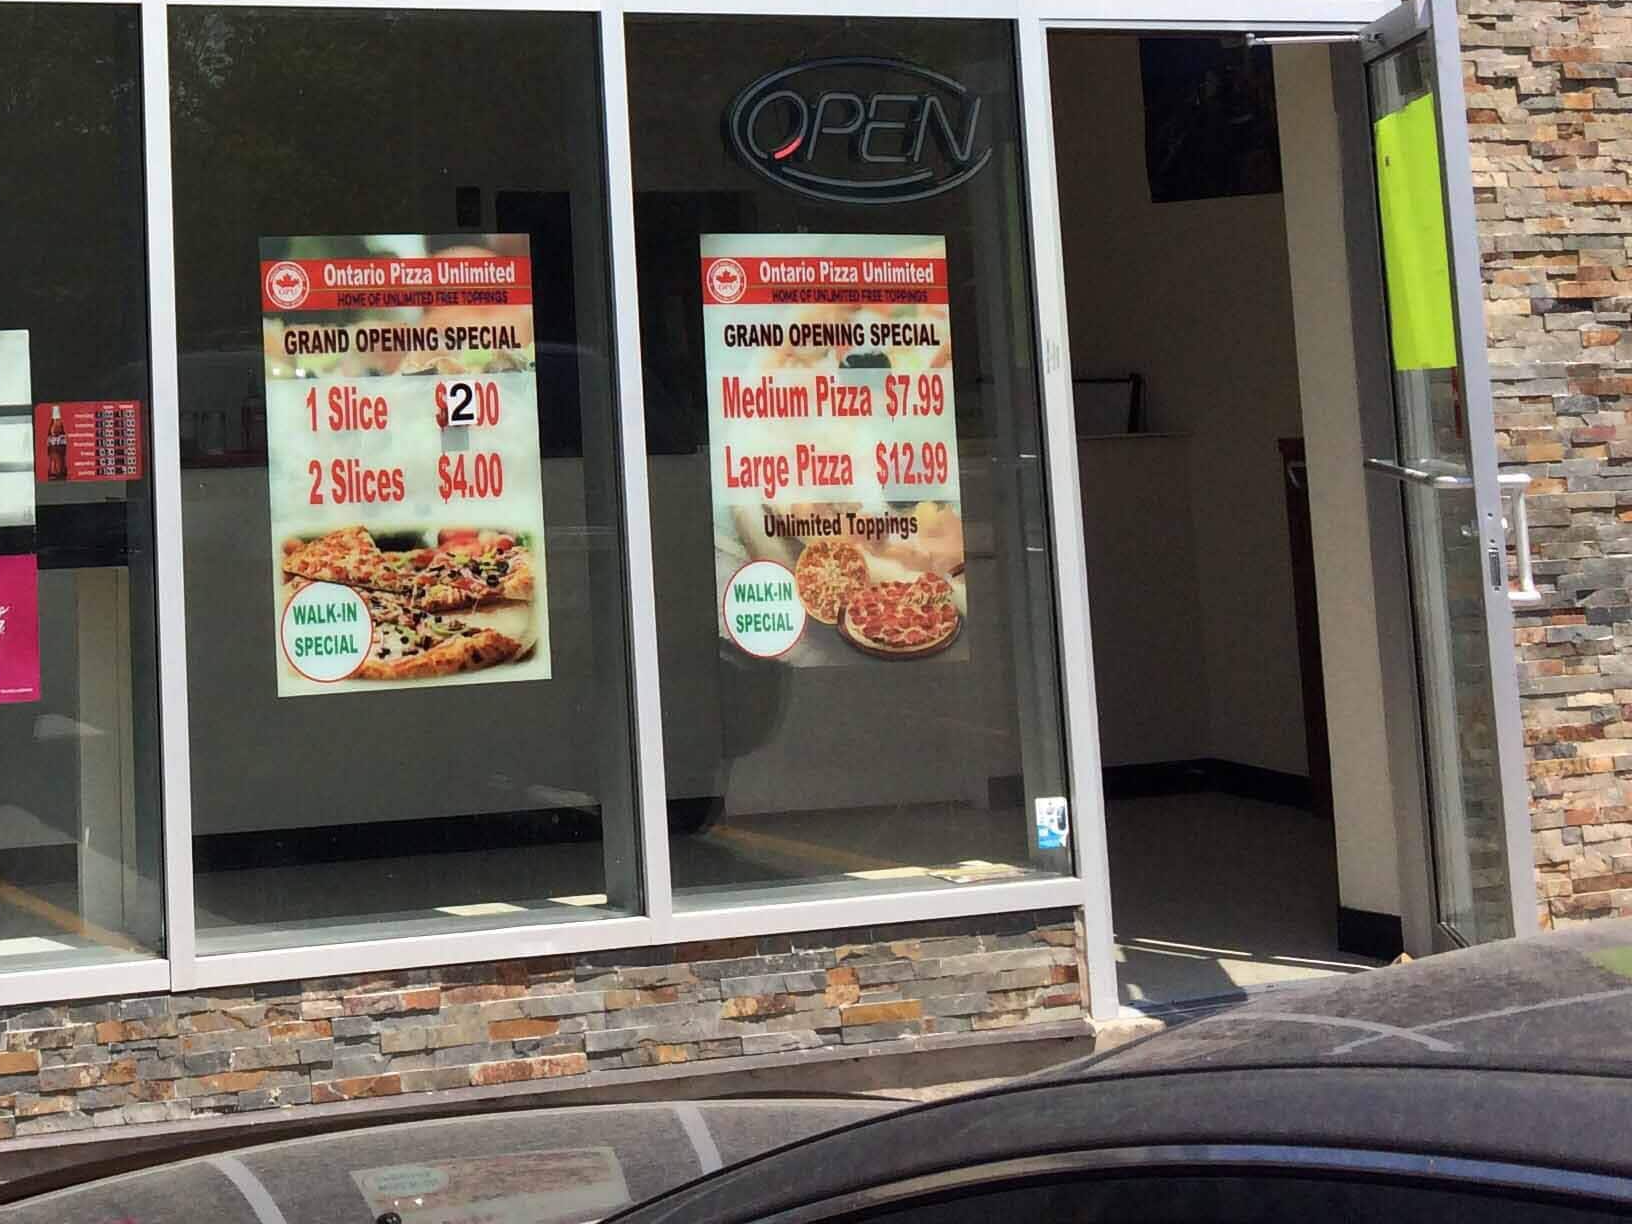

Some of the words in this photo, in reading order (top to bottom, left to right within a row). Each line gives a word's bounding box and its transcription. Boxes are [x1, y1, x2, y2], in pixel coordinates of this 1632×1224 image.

[747, 89, 982, 163] OPEN
[324, 264, 385, 287] Ontario
[390, 262, 433, 285] Pizza
[437, 261, 516, 284] Unlimited
[759, 261, 816, 283] Ontario
[819, 261, 859, 283] Pizza
[862, 261, 935, 284] Unlimited
[337, 293, 367, 307] HOME
[368, 293, 382, 306] OF
[383, 292, 434, 306] UNLIMITED
[435, 291, 459, 305] FREE
[772, 289, 799, 303] HOME
[284, 329, 350, 355] GRAND
[356, 327, 438, 353] OPENING
[444, 325, 521, 351] SPECIAL
[724, 324, 784, 347] GRAND
[789, 324, 865, 347] OPENING
[870, 323, 941, 346] SPECIAL
[305, 387, 318, 432] 1
[328, 386, 389, 431] Slice
[721, 376, 809, 419] Medium
[815, 375, 873, 418] Pizza
[885, 374, 945, 423] $7.99
[308, 459, 324, 505] 2
[330, 458, 406, 504] Slices
[438, 452, 504, 503] $4.00
[724, 445, 789, 500] Large
[795, 443, 854, 487] Pizza
[875, 440, 949, 490] $12.99
[764, 513, 842, 538] Unlimited
[846, 512, 919, 541] Toppings
[733, 582, 793, 604] WALK-IN
[292, 602, 358, 625] WALK-IN
[735, 613, 794, 634] SPECIAL
[295, 634, 359, 657] SPECIAL
